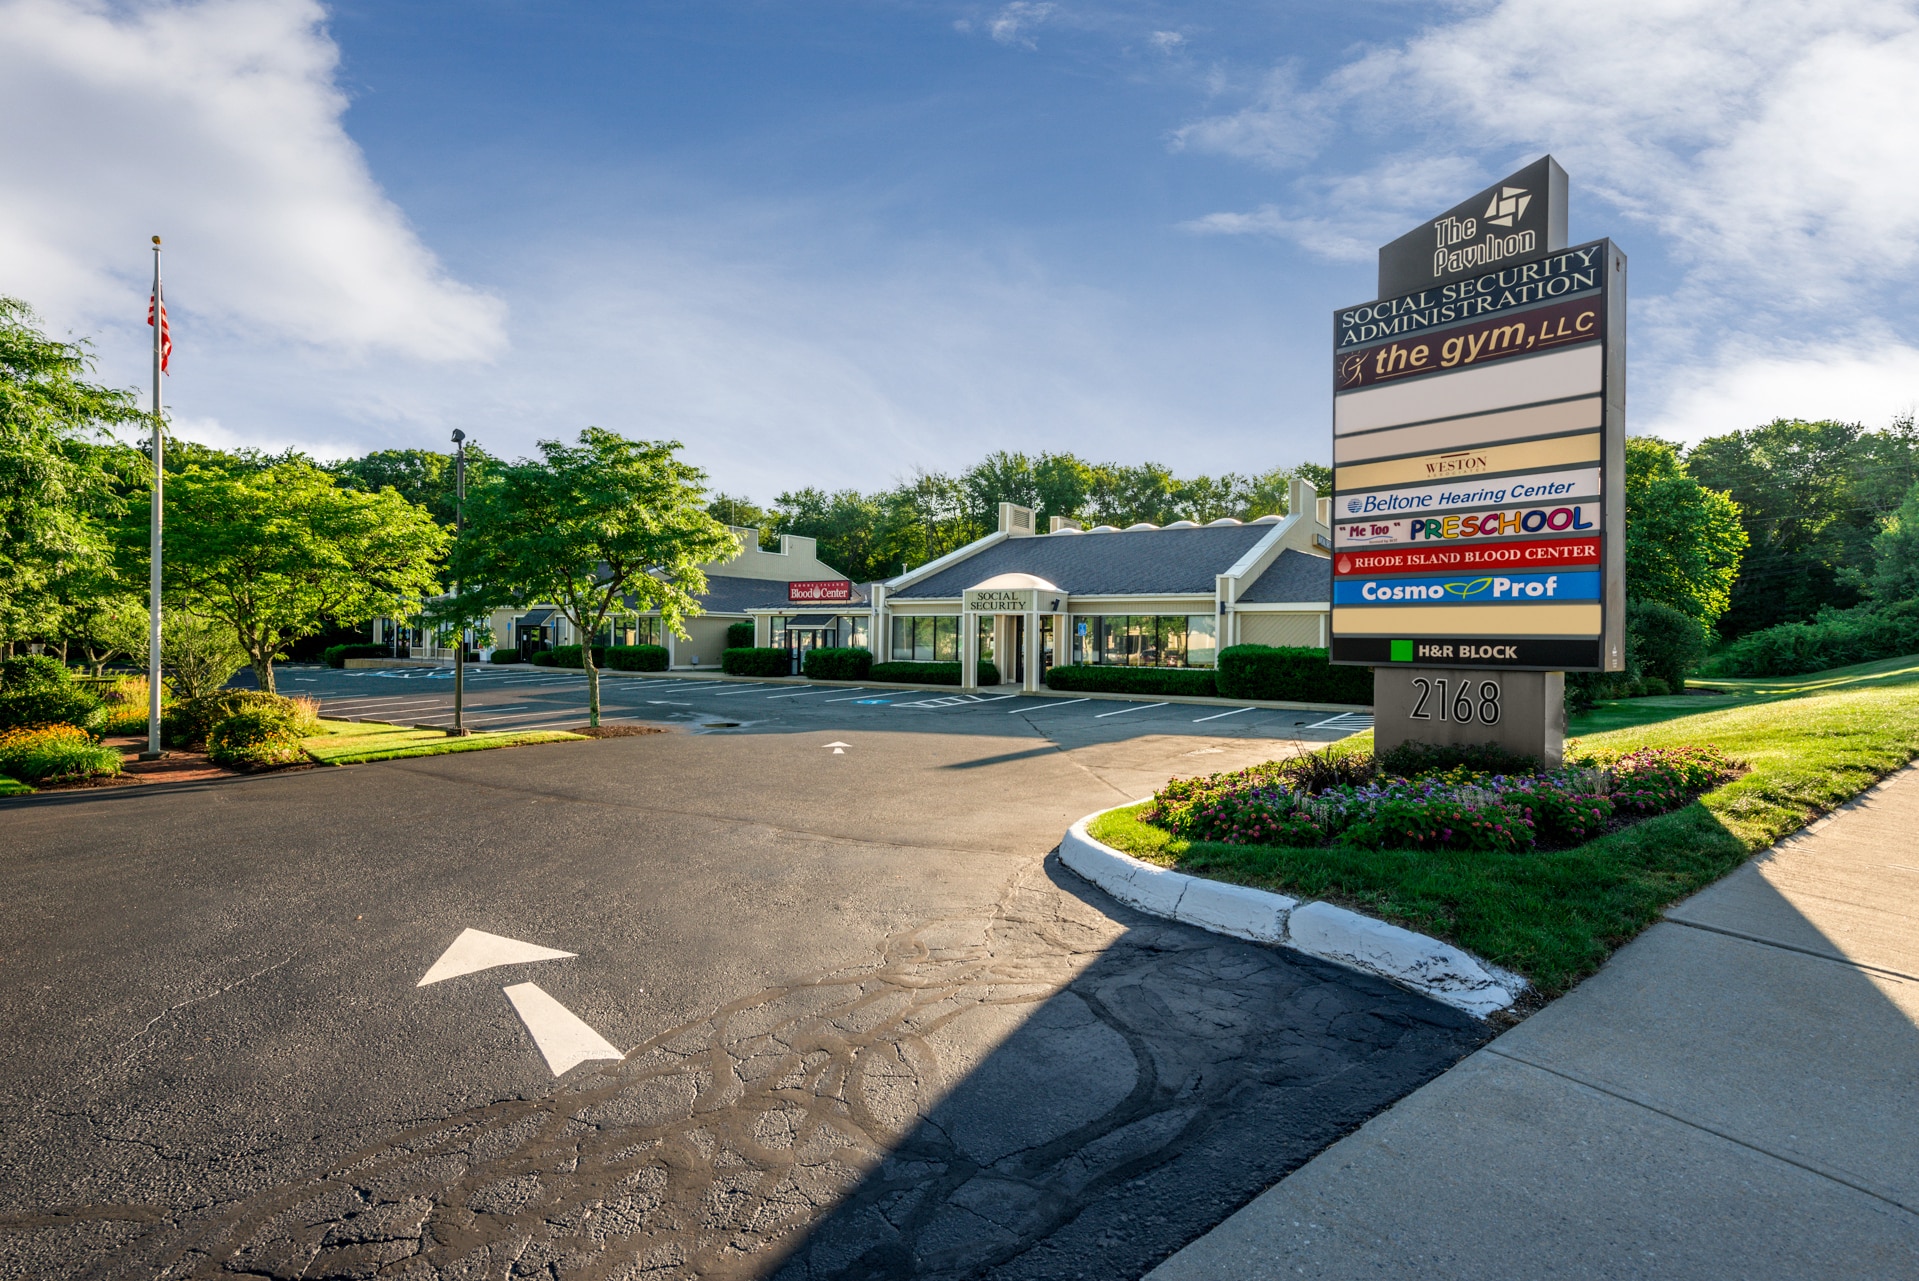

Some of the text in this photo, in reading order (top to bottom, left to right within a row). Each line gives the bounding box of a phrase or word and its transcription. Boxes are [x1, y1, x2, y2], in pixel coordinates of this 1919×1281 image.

[1434, 216, 1477, 248] The
[1433, 229, 1536, 278] Pavilion
[1342, 245, 1600, 329] SOCIAL SECURITY
[1341, 267, 1597, 347] ADMINISTRATION
[1375, 344, 1430, 375] the
[1425, 455, 1488, 474] WESTON
[1363, 480, 1575, 513] Beltone Hearing Center
[1410, 506, 1593, 540] PRESCHOOL
[1354, 544, 1597, 568] RHODE ISLAND BLOOD CENTER
[791, 588, 848, 598] Blood Center
[977, 592, 1019, 600] SOCIAL
[1362, 576, 1558, 601] Cosmo Prof
[970, 601, 1027, 610] SECURITY
[1418, 645, 1518, 659] H&R BLOCK
[1409, 677, 1501, 726] 2168
